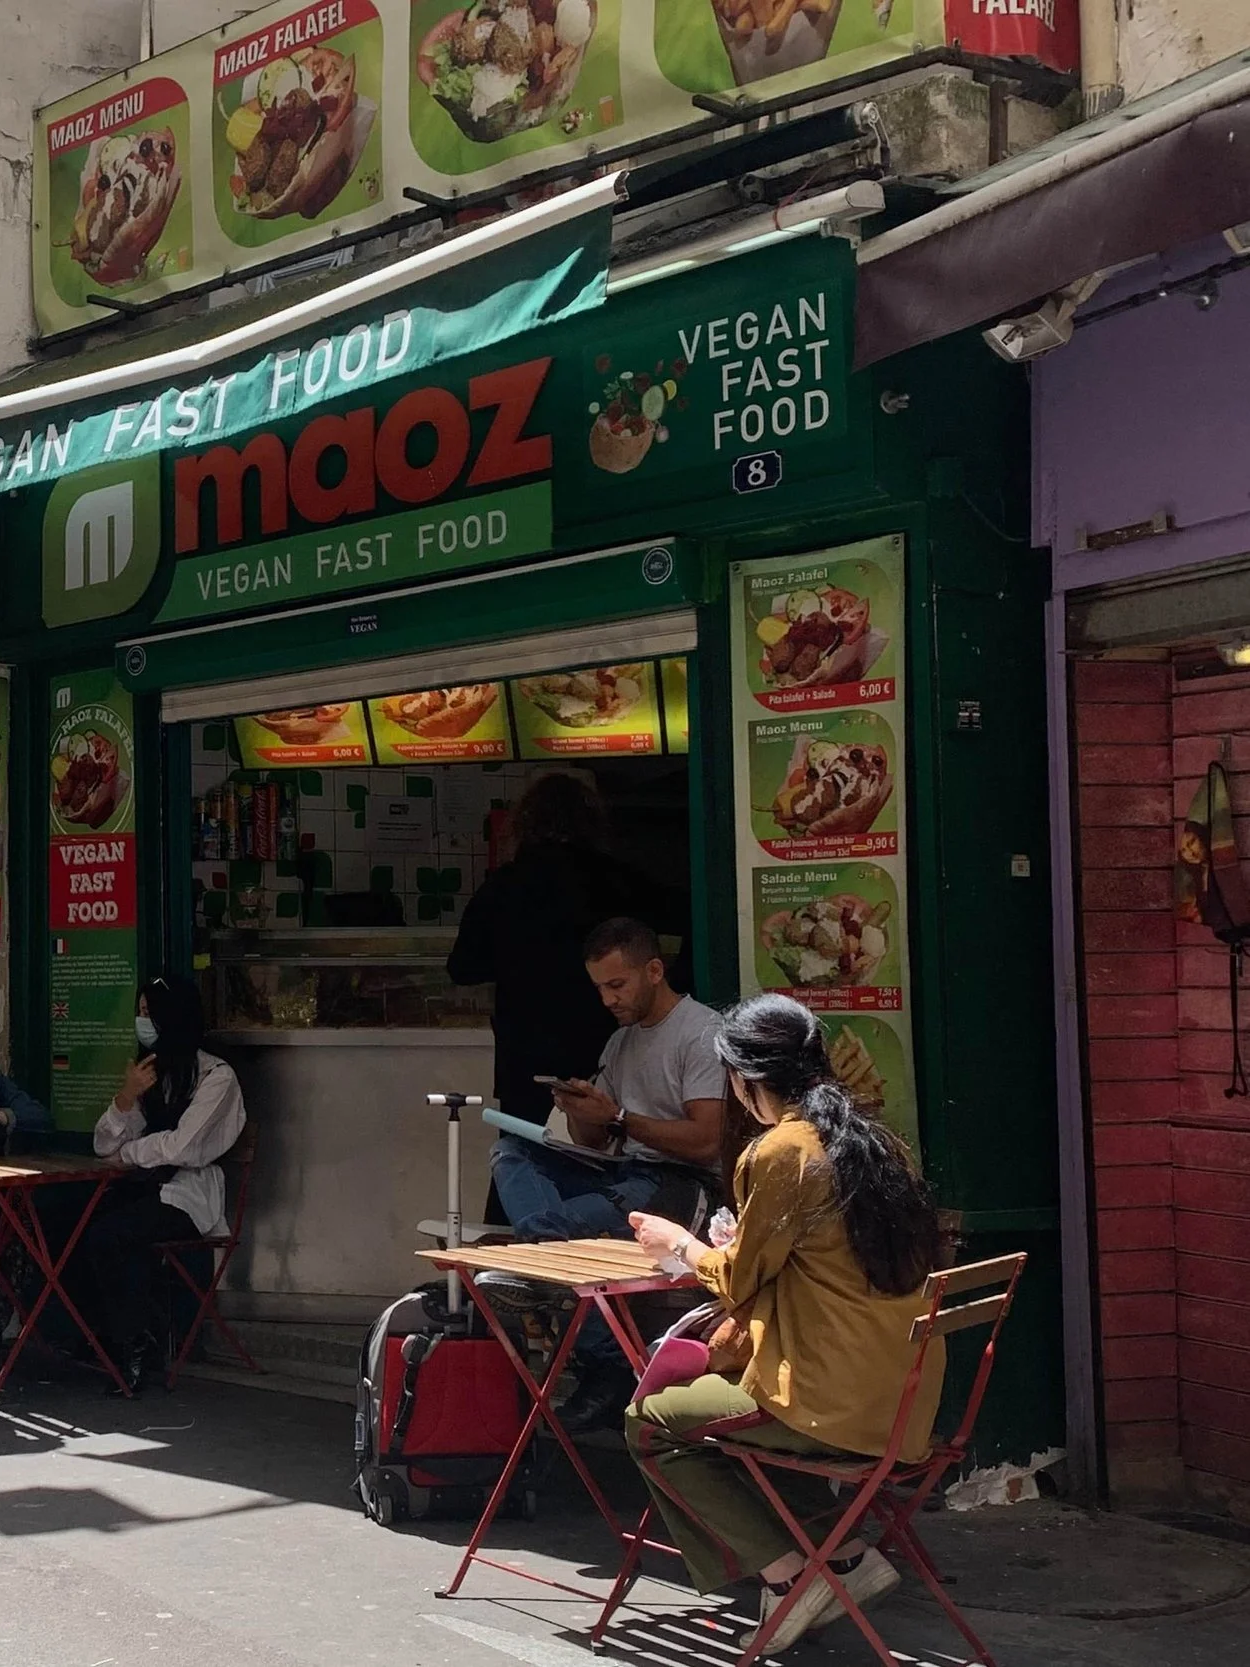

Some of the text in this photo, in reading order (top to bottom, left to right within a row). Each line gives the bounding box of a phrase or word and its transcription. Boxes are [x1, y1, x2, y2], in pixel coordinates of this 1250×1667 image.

[219, 2, 347, 79] MAOZ FALAFEL
[51, 90, 144, 151] MAOZ MENU
[677, 293, 827, 364] VEGAN
[103, 374, 236, 454] FAST
[269, 309, 412, 410] FOOD
[721, 340, 830, 402] FAST
[713, 389, 830, 449] FOOD
[174, 357, 555, 554] maoz
[747, 459, 767, 486] 8
[197, 509, 508, 601] VEGAN FAST FOOD
[751, 568, 828, 589] Maoz Falafel
[859, 683, 890, 698] 6,00 €
[61, 708, 91, 735] MAOZ
[756, 720, 823, 736] Maoz Menu
[333, 748, 352, 759] 6,00
[473, 744, 495, 755] 9,90
[60, 841, 125, 866] VEGAN
[867, 837, 888, 851] 9,90
[70, 872, 115, 893] FAST
[761, 872, 837, 885] Salade Menu
[68, 901, 119, 923] FOOD
